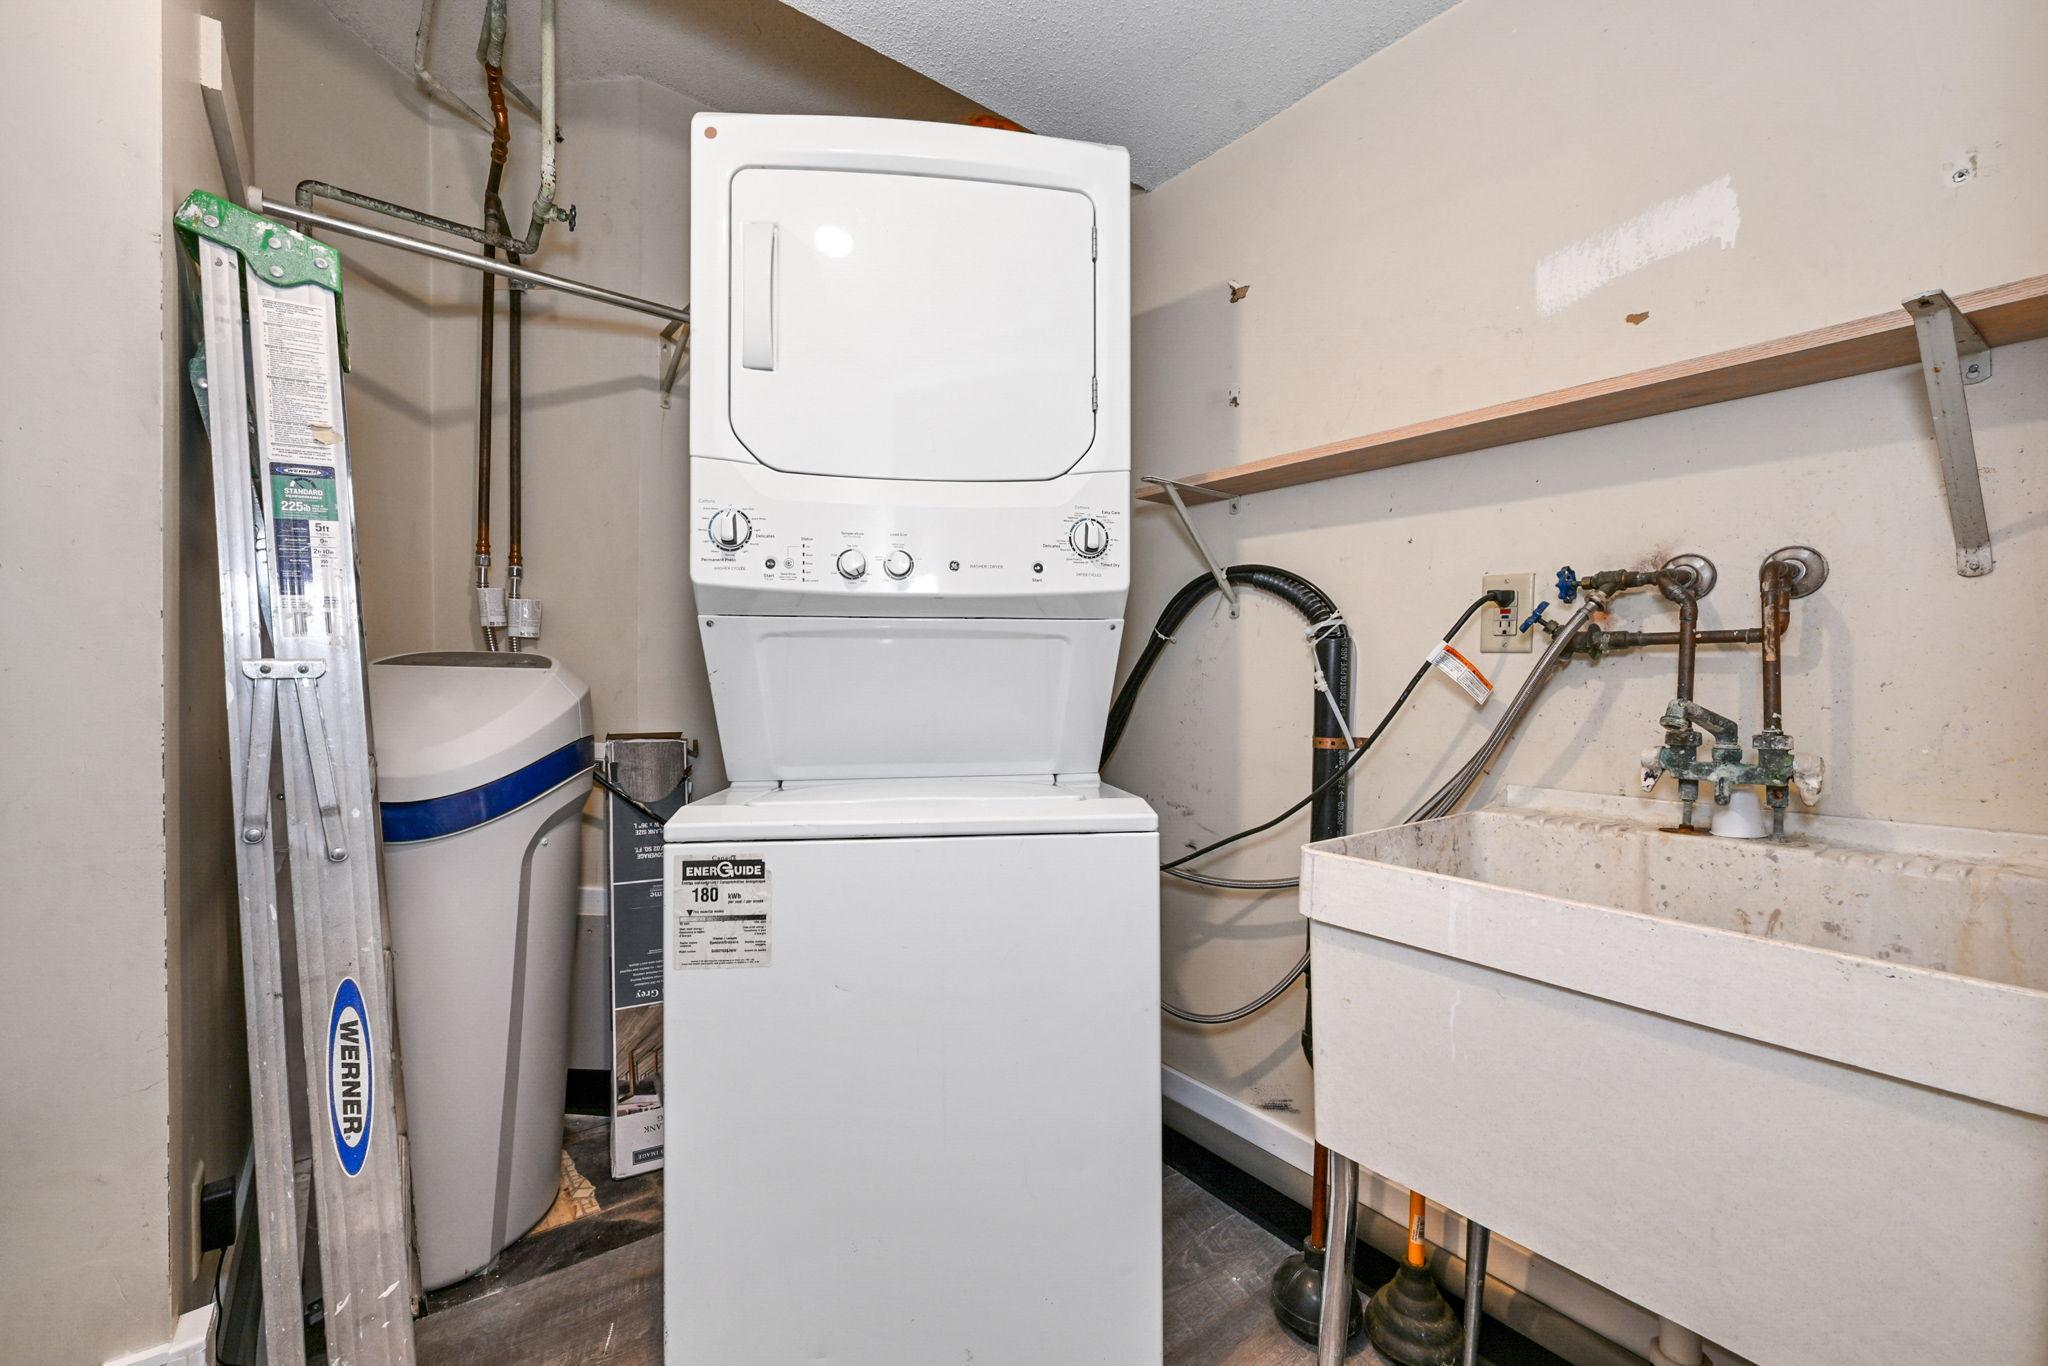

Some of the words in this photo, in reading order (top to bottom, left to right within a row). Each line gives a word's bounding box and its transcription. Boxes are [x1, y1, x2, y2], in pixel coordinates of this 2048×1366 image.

[284, 488, 323, 496] STANDARD
[315, 523, 330, 532] 5ft
[686, 861, 762, 878] ENERGUIDE
[692, 887, 719, 902] 180
[635, 989, 659, 998] Grey
[339, 1019, 362, 1135] WERNER
